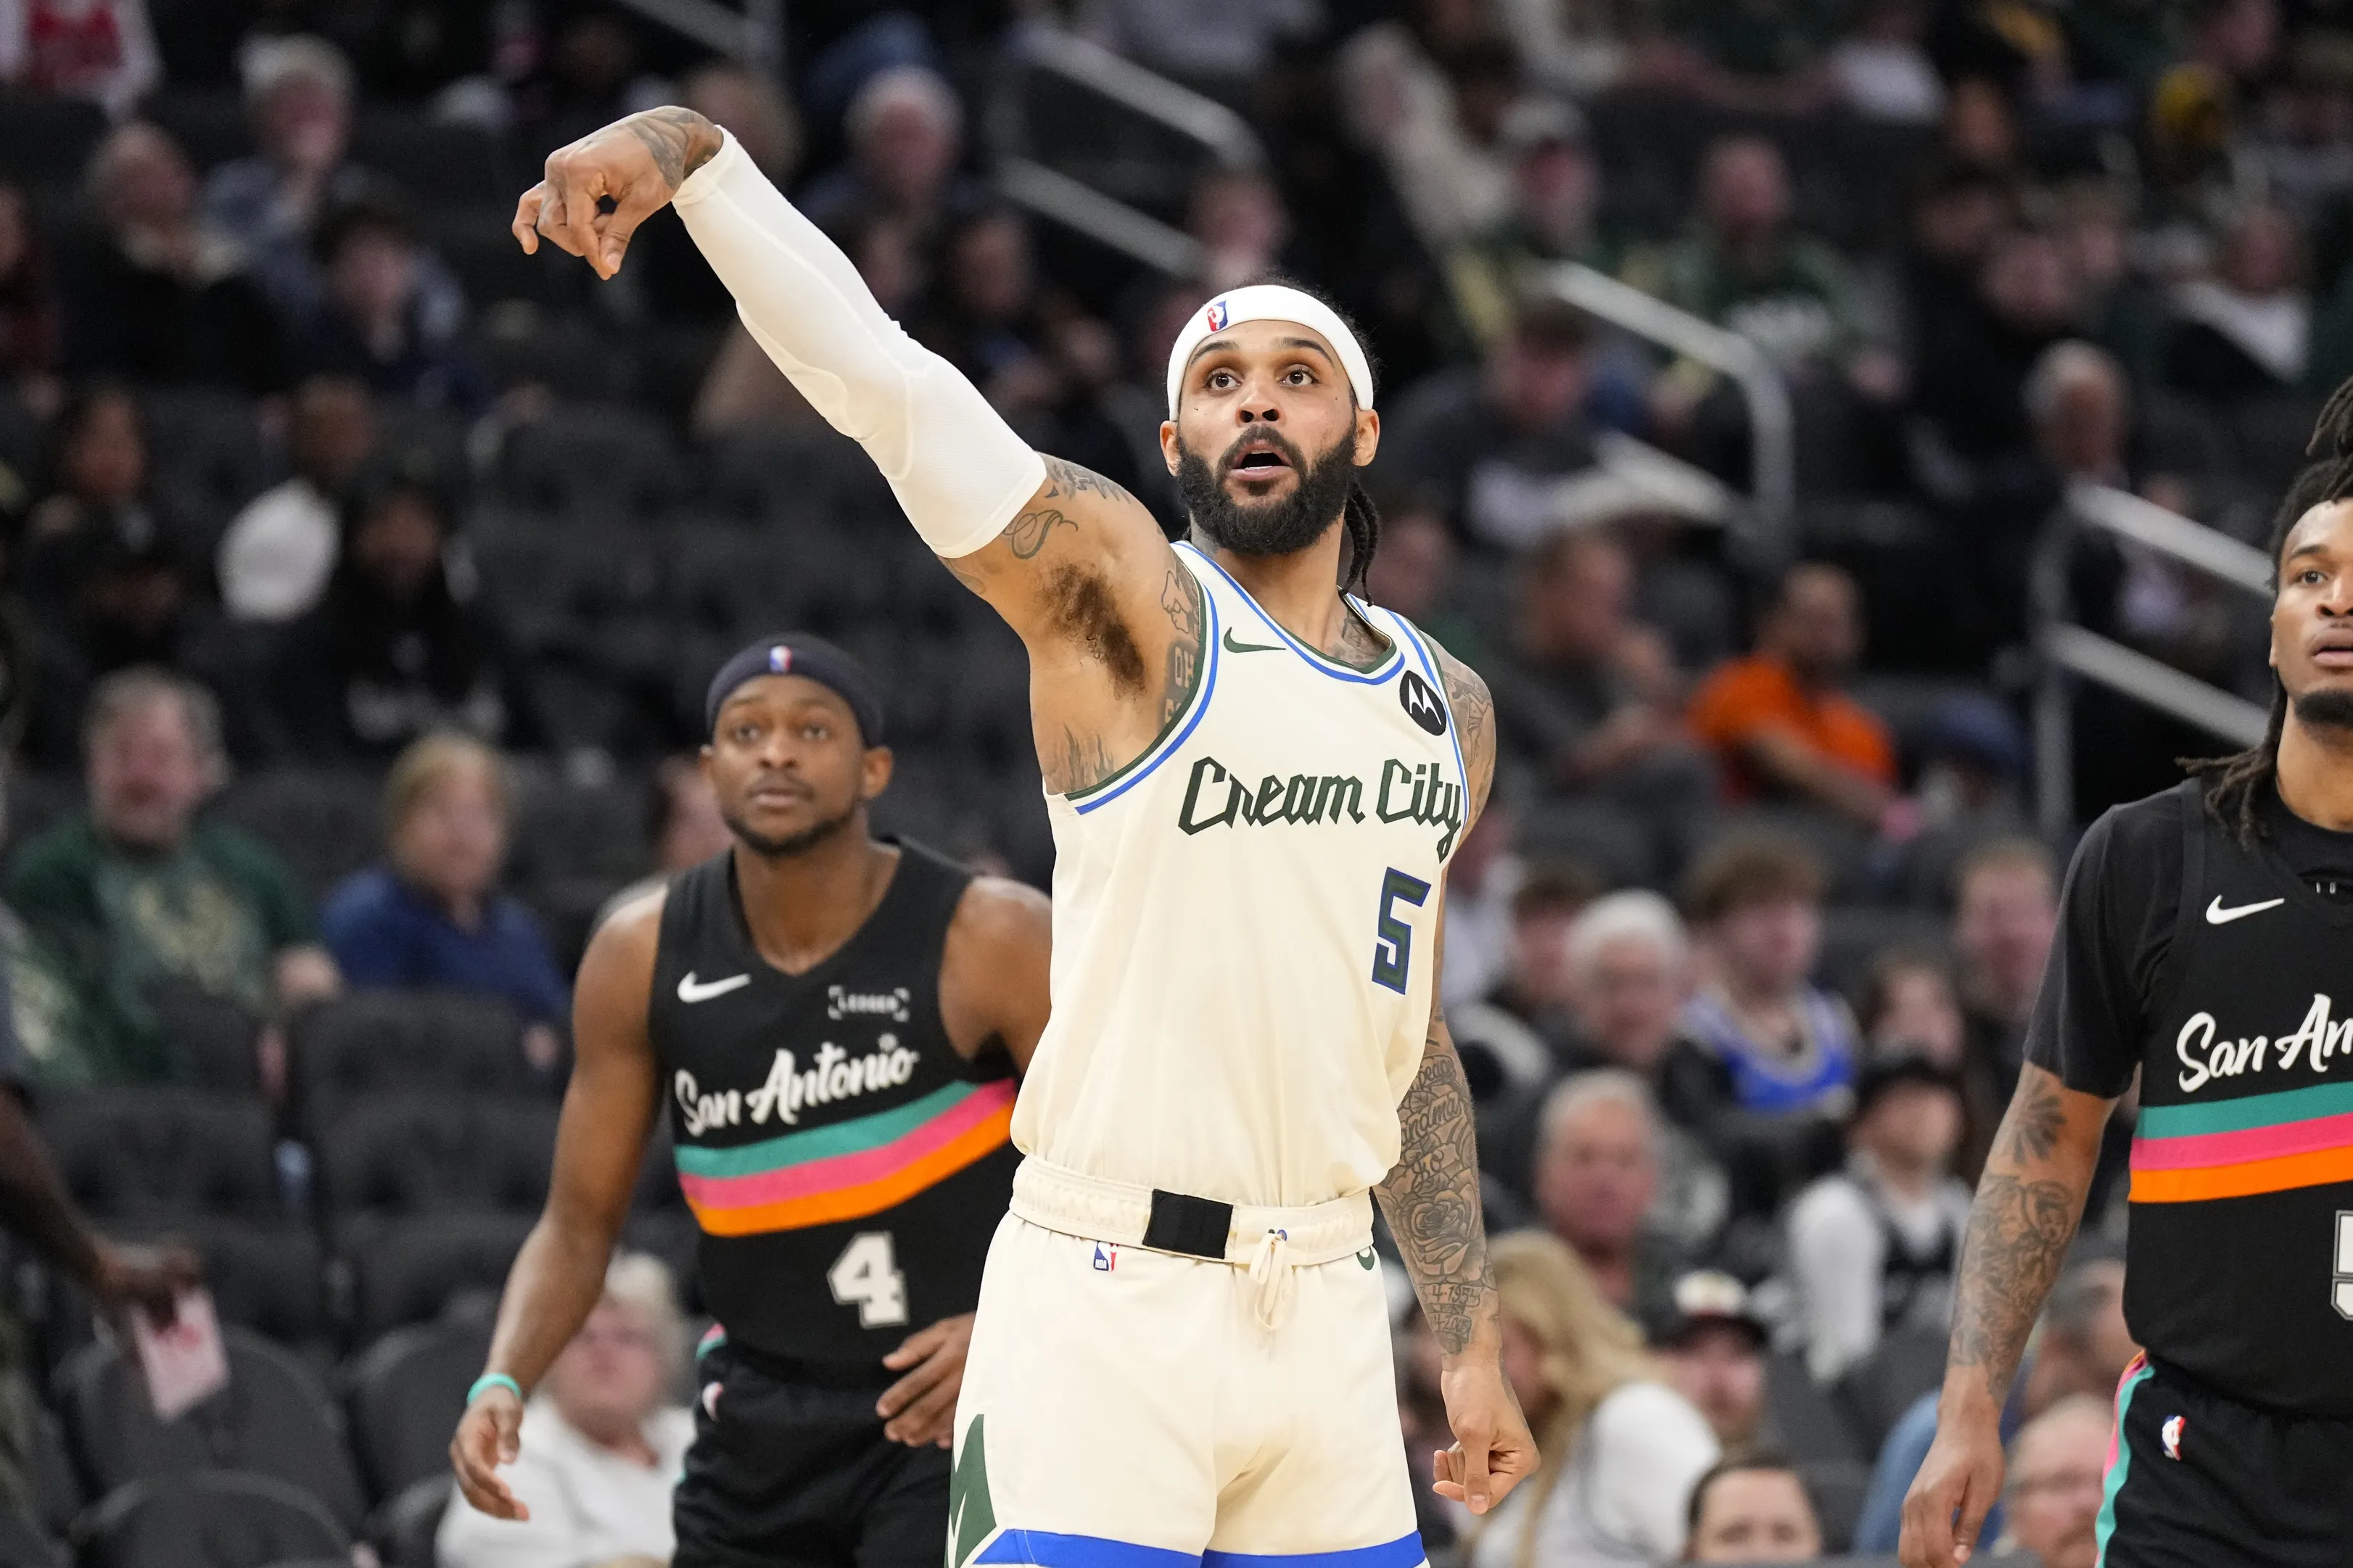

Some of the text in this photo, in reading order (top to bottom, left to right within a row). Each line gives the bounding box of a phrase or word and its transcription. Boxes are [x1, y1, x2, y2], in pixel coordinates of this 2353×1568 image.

[1177, 756, 1462, 865] Cream City
[1372, 866, 1431, 995] 5
[675, 1033, 920, 1138] San Antonio
[2176, 1011, 2268, 1093] San
[826, 1231, 910, 1330] 4
